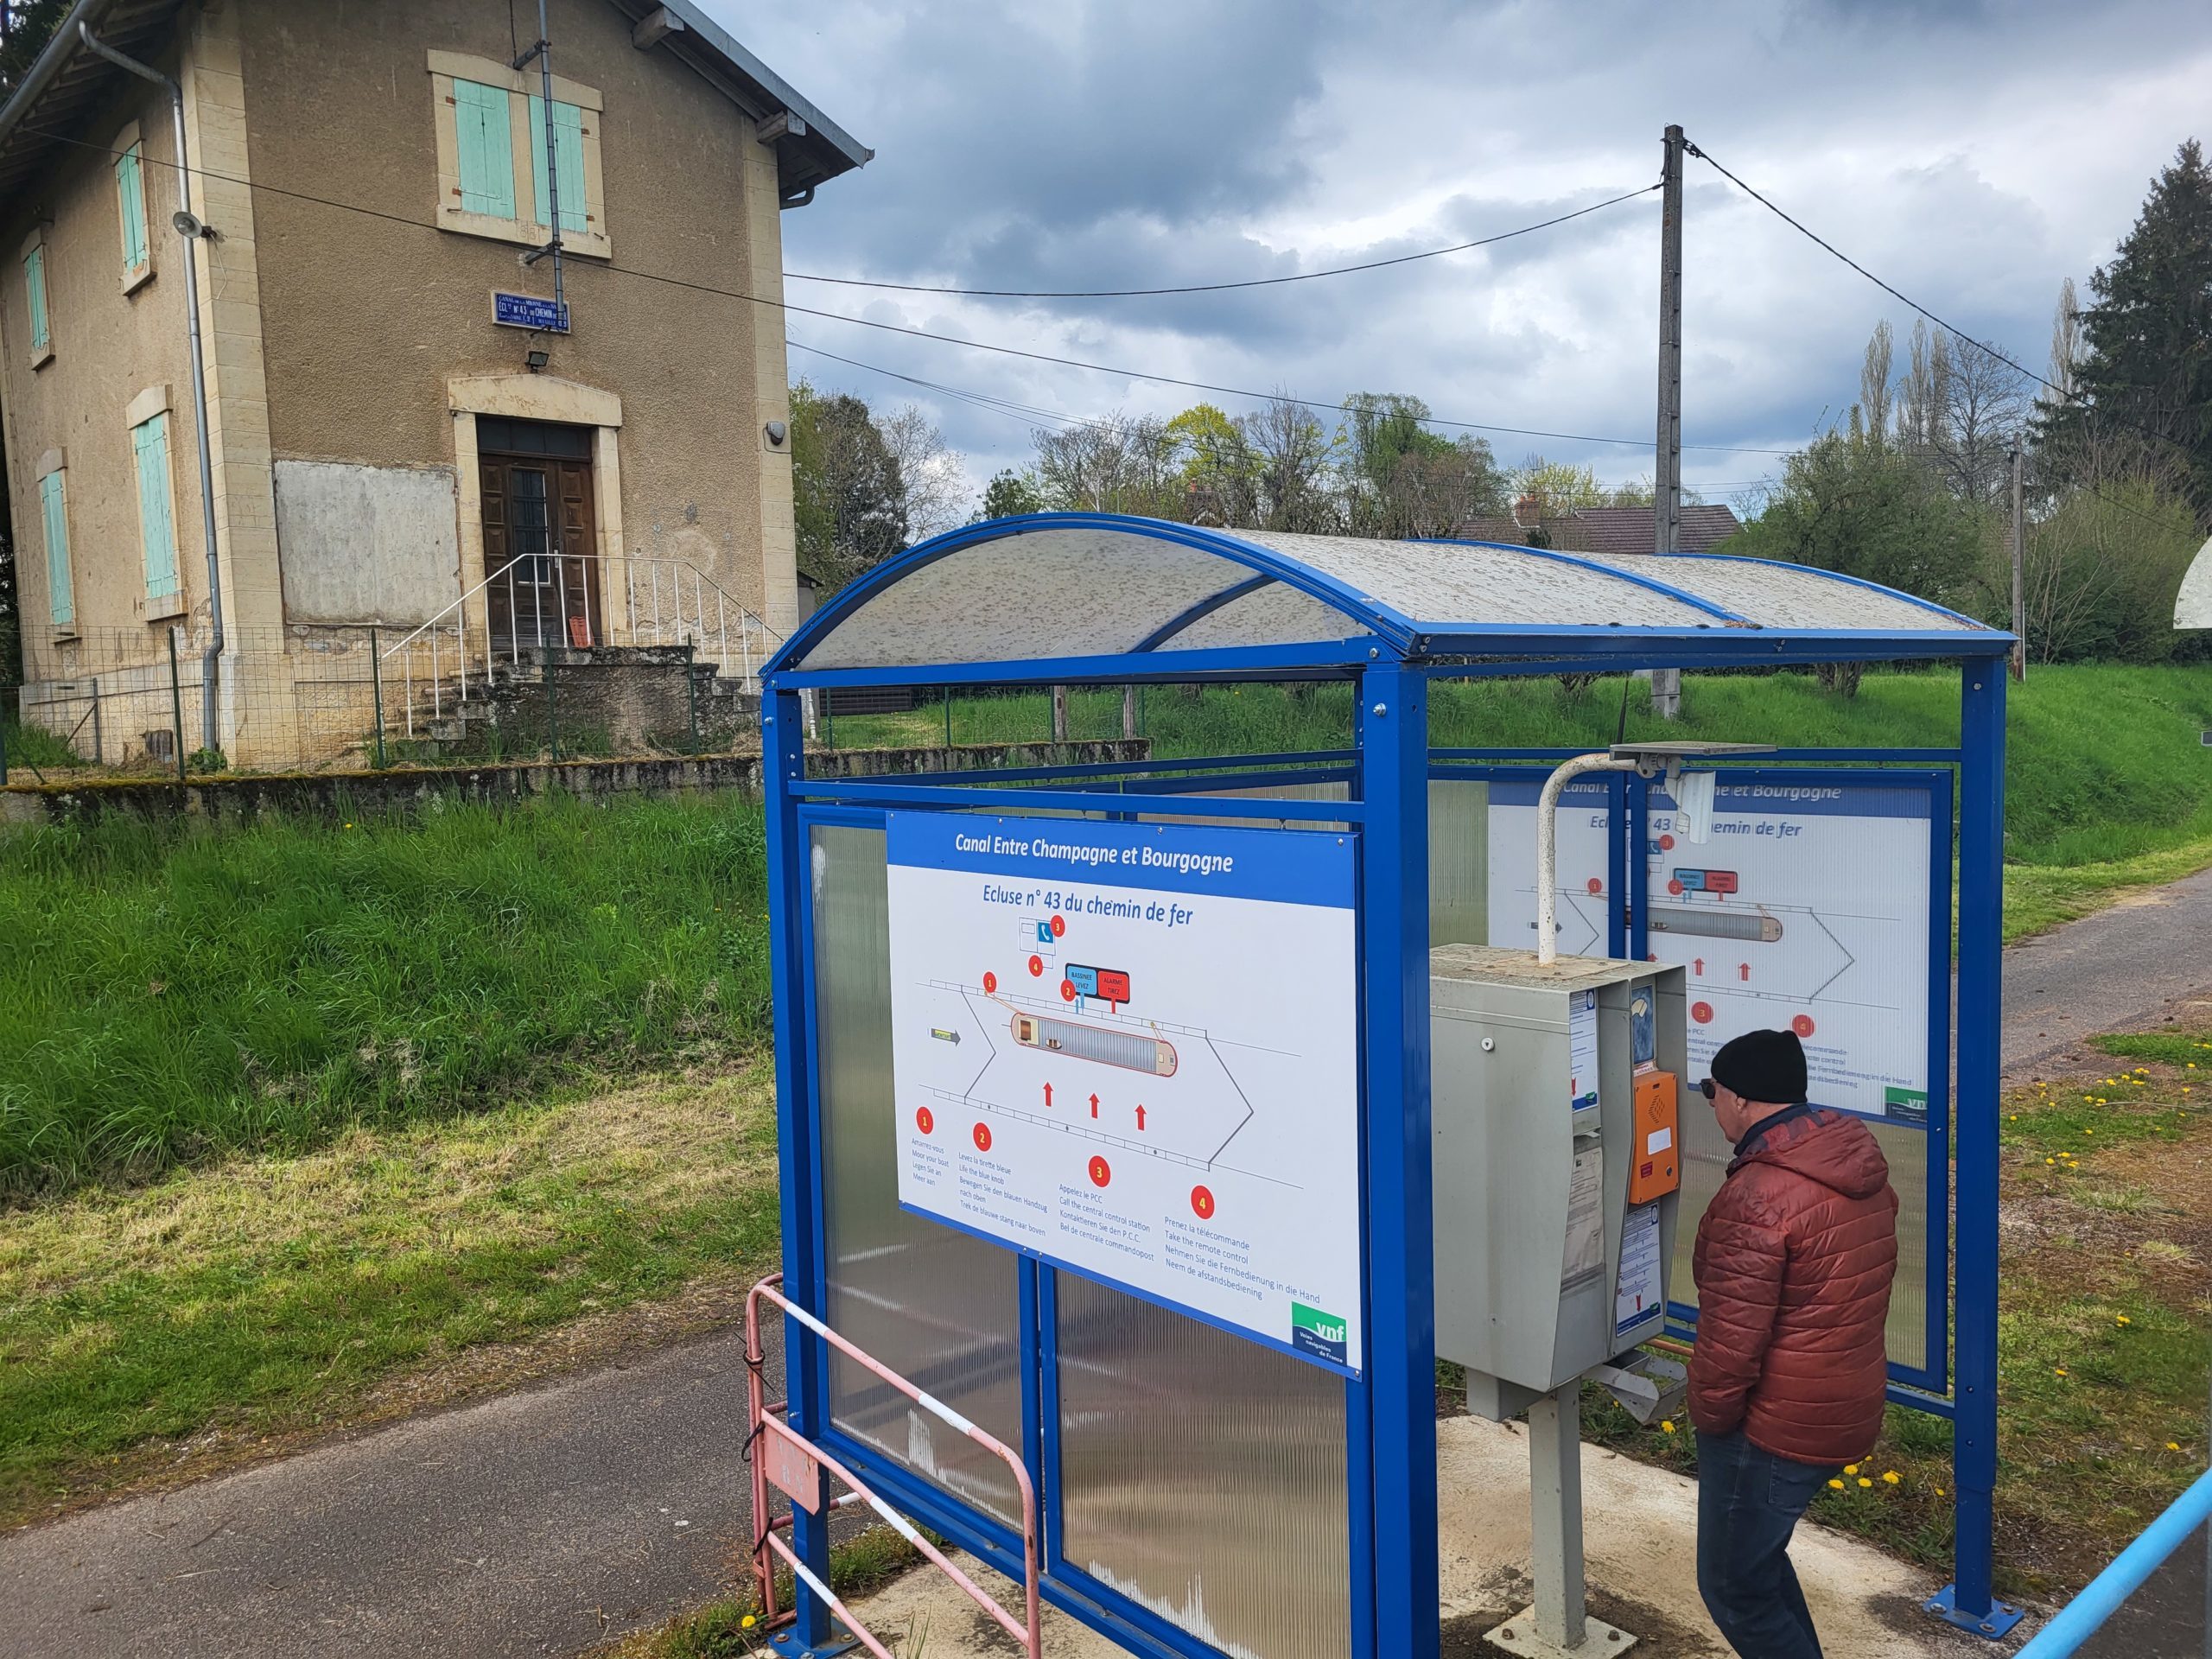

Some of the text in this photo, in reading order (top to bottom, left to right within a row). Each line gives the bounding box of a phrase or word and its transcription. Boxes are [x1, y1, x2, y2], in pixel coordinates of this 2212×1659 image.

[520, 305, 527, 315] 43
[535, 308, 553, 318] CHEMIN
[1563, 783, 1599, 793] Canal
[1733, 785, 1749, 797] et
[1752, 785, 1842, 801] Bourgogne
[1653, 818, 1671, 830] 43
[1756, 821, 1775, 836] de
[1776, 822, 1802, 839] fer
[956, 833, 1233, 875] Canal Entre Champagne et Bourgogne
[983, 884, 1193, 927] Ecluse n° 43 du chemin de fer
[1056, 923, 1060, 931] 3
[1033, 963, 1039, 971] 4
[988, 979, 992, 988] 1
[1103, 977, 1122, 986] ALARME
[1065, 988, 1071, 996] 2
[1892, 1077, 1912, 1086] Hand
[922, 1116, 928, 1127] 1
[912, 1138, 944, 1154] Amarrez-vous
[980, 1133, 985, 1144] 2
[912, 1149, 949, 1167] Moor your boat
[958, 1152, 1012, 1175] Levez la tirette bleue
[912, 1161, 926, 1173] Legen
[926, 1165, 935, 1174] Sie
[969, 1166, 978, 1177] the
[978, 1170, 990, 1181] blue
[991, 1173, 1005, 1185] knob
[1096, 1166, 1103, 1179] 3
[912, 1173, 936, 1186] Meer aan
[959, 1176, 1048, 1214] Bewegen Sie den blauen Handzug
[959, 1189, 986, 1204] nach oben
[1058, 1184, 1103, 1204] Appelez le PCC
[1199, 1197, 1206, 1210] 4
[960, 1199, 1046, 1237] Trek de blauwe stang naar boven
[1059, 1196, 1151, 1233] Call the central control station
[1059, 1210, 1141, 1243] Kontaktieren Sie den P.C.C.
[1165, 1216, 1250, 1251] Prenez la télécommande
[1060, 1222, 1154, 1262] Bel de centrale commandopost
[1165, 1230, 1249, 1265] Take the remote control
[1165, 1244, 1320, 1304] Nehmen Sie die Fernbedienung in die Hand
[1166, 1258, 1262, 1300] Neem de afstandsbediening
[1300, 1332, 1313, 1340] Voies
[1316, 1322, 1344, 1341] vnf
[1326, 1352, 1343, 1363] France
